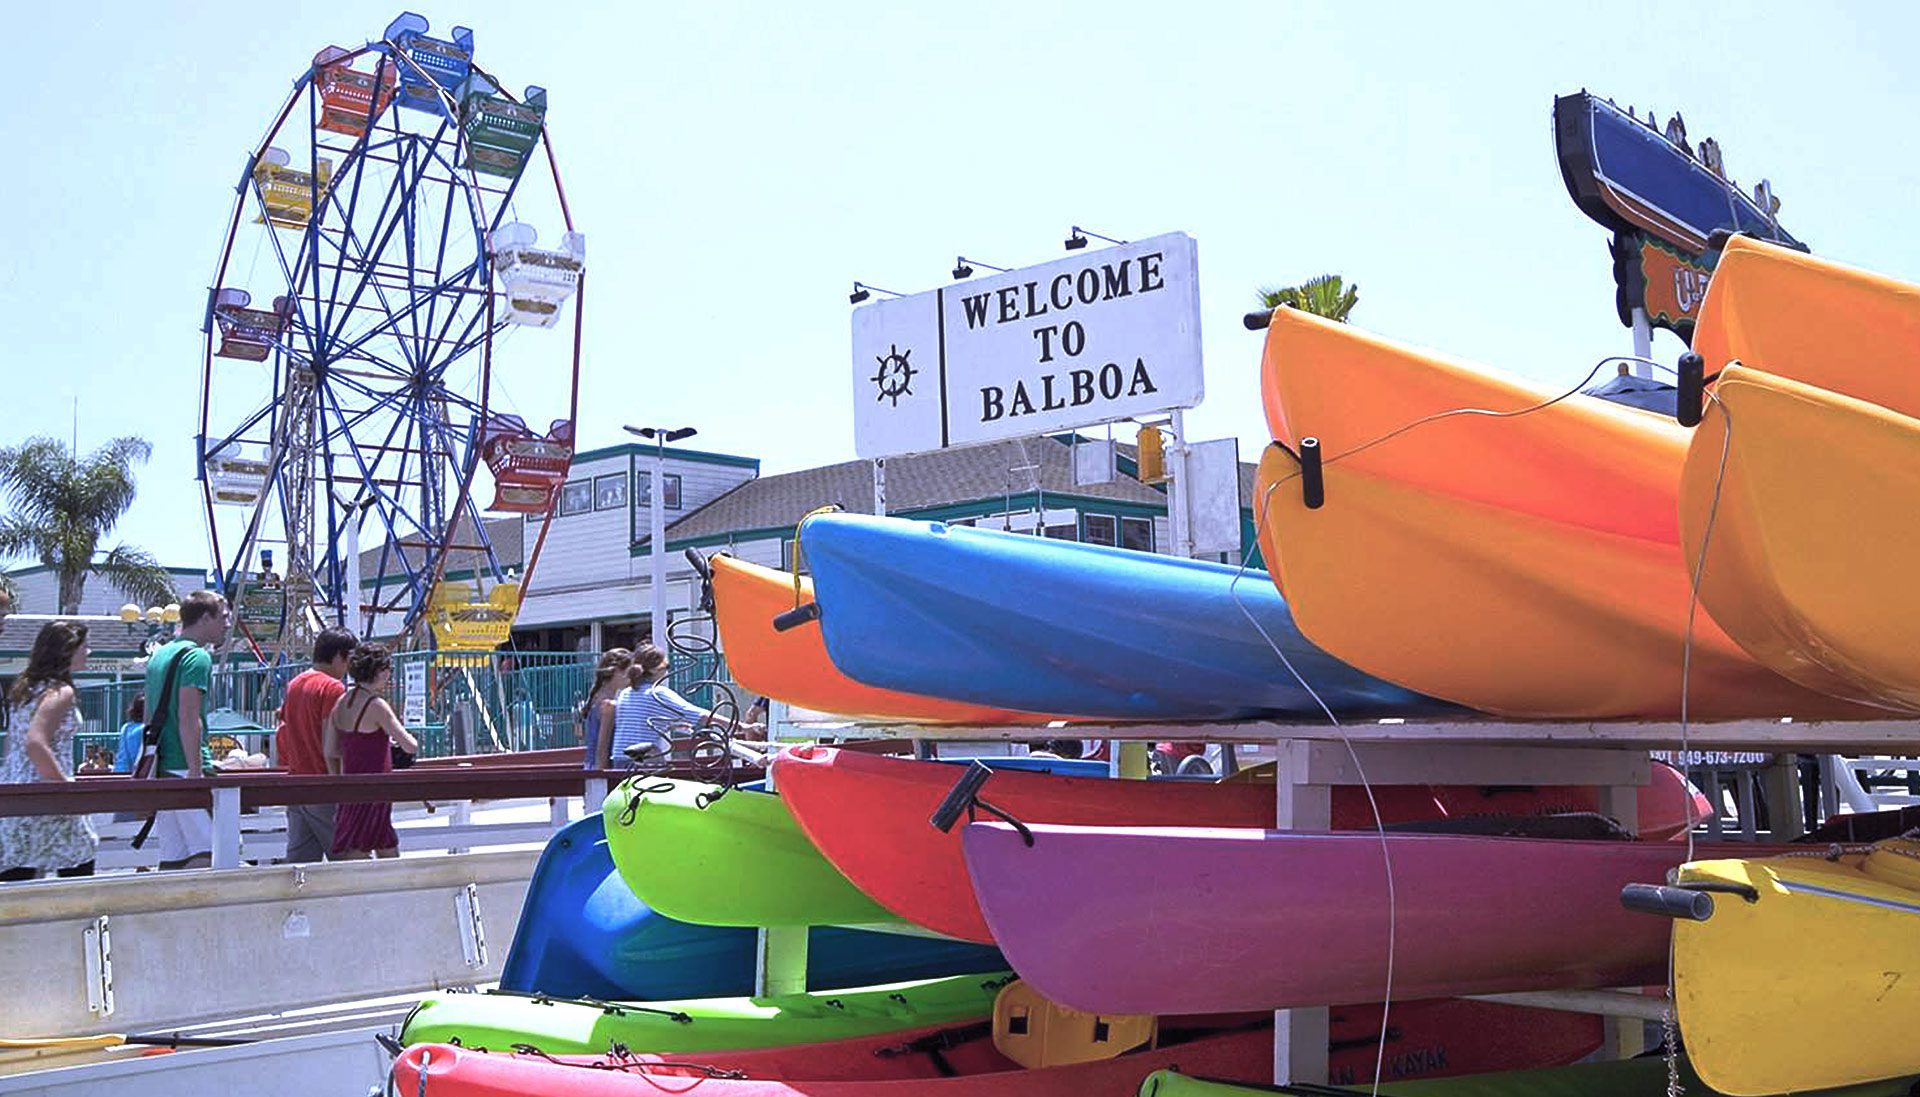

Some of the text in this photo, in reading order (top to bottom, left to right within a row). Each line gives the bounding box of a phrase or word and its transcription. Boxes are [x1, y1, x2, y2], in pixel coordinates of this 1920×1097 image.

[961, 252, 1165, 330] WELCOME
[1033, 320, 1086, 363] TO
[979, 357, 1158, 423] BALBOA
[1386, 1047, 1447, 1078] KAYAK
